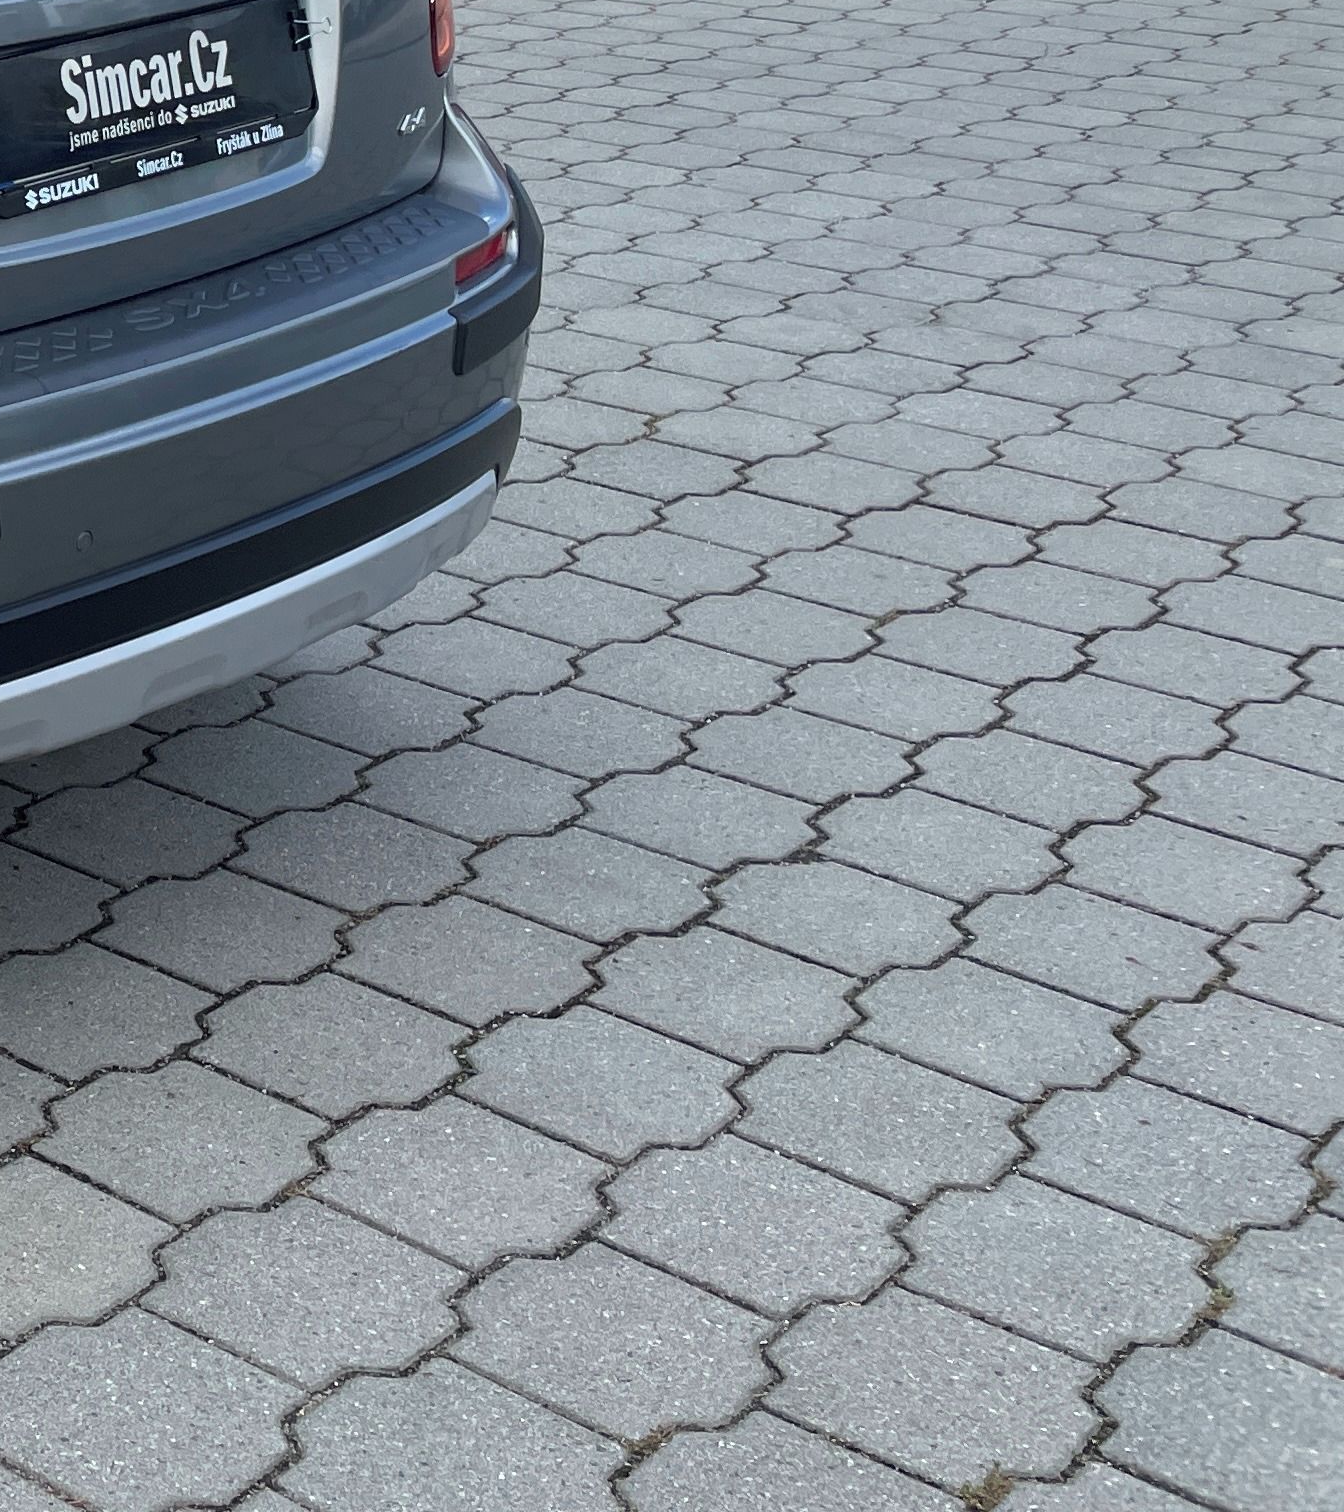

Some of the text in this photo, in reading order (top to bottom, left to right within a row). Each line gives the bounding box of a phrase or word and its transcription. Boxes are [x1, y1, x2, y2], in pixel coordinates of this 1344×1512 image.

[60, 29, 233, 124] Simcar.Cz
[69, 95, 236, 153] jsme nadšenci do SUZUKI
[216, 123, 285, 156] Fryšták u Zlína
[136, 149, 184, 178] Simcar.Cz
[38, 173, 100, 205] SUZUKI
[122, 279, 267, 333] SX4
